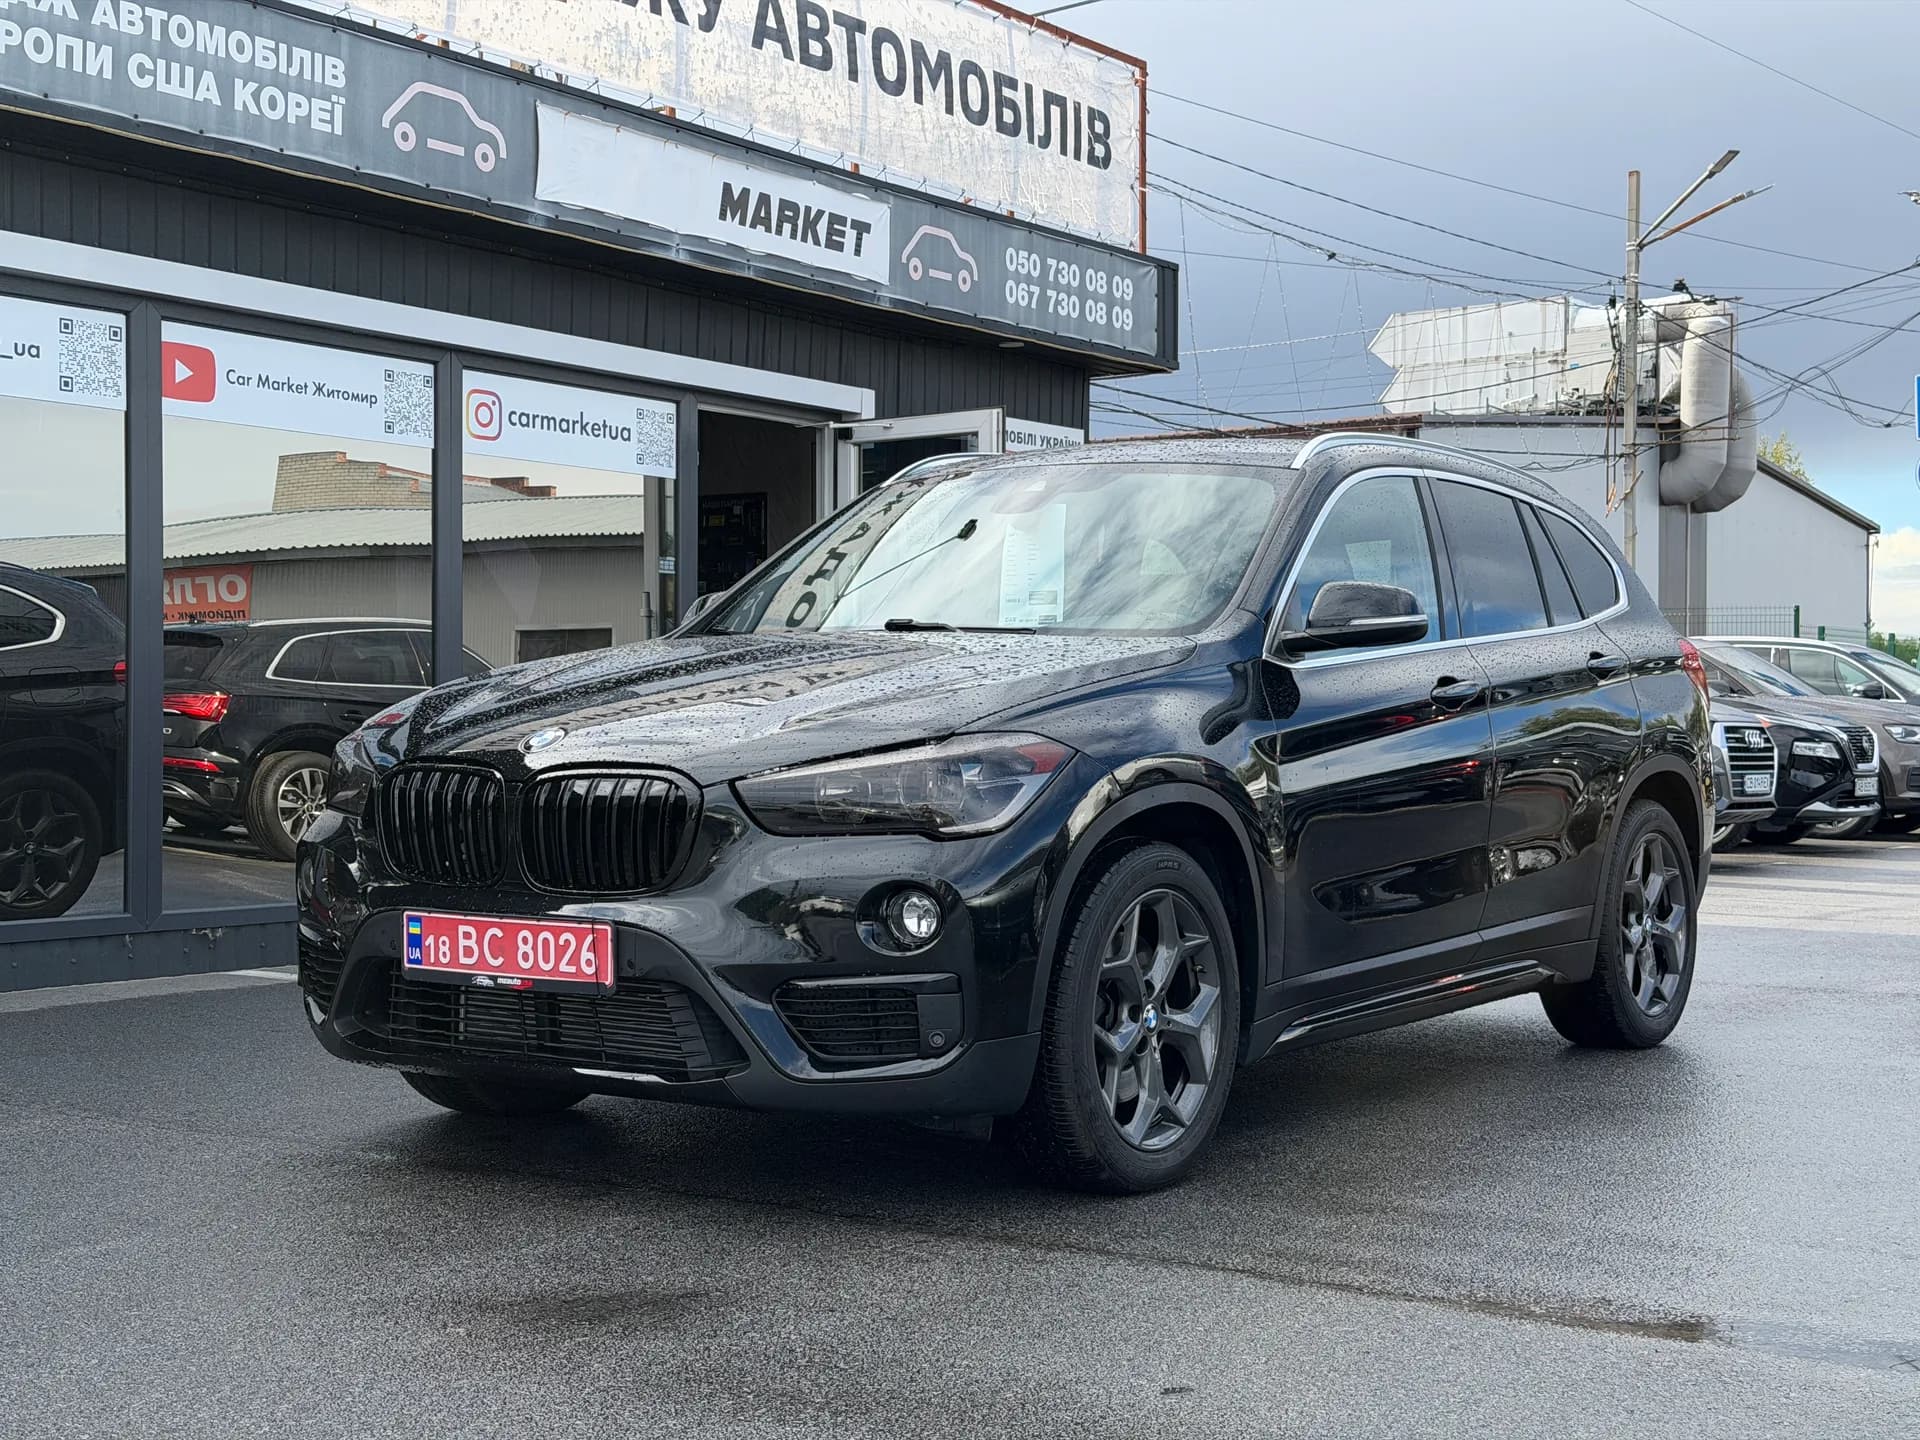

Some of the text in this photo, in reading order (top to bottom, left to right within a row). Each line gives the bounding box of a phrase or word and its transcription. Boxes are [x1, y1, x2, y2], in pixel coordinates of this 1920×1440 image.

[91, 0, 346, 88] АВТОМОБІЛІВ
[127, 52, 221, 106] США
[234, 78, 346, 136] КОРЕЇ
[752, 0, 1112, 170] АВТОМОБІЛІВ
[719, 181, 872, 257] MARKET
[1005, 247, 1133, 301] 050 730 08 09
[1005, 280, 1133, 331] 067 730 08 09
[226, 369, 378, 408] Car Market Житомир
[508, 410, 632, 442] carmarketua
[408, 947, 421, 960] UA
[424, 924, 598, 976] 18 BC 8026
